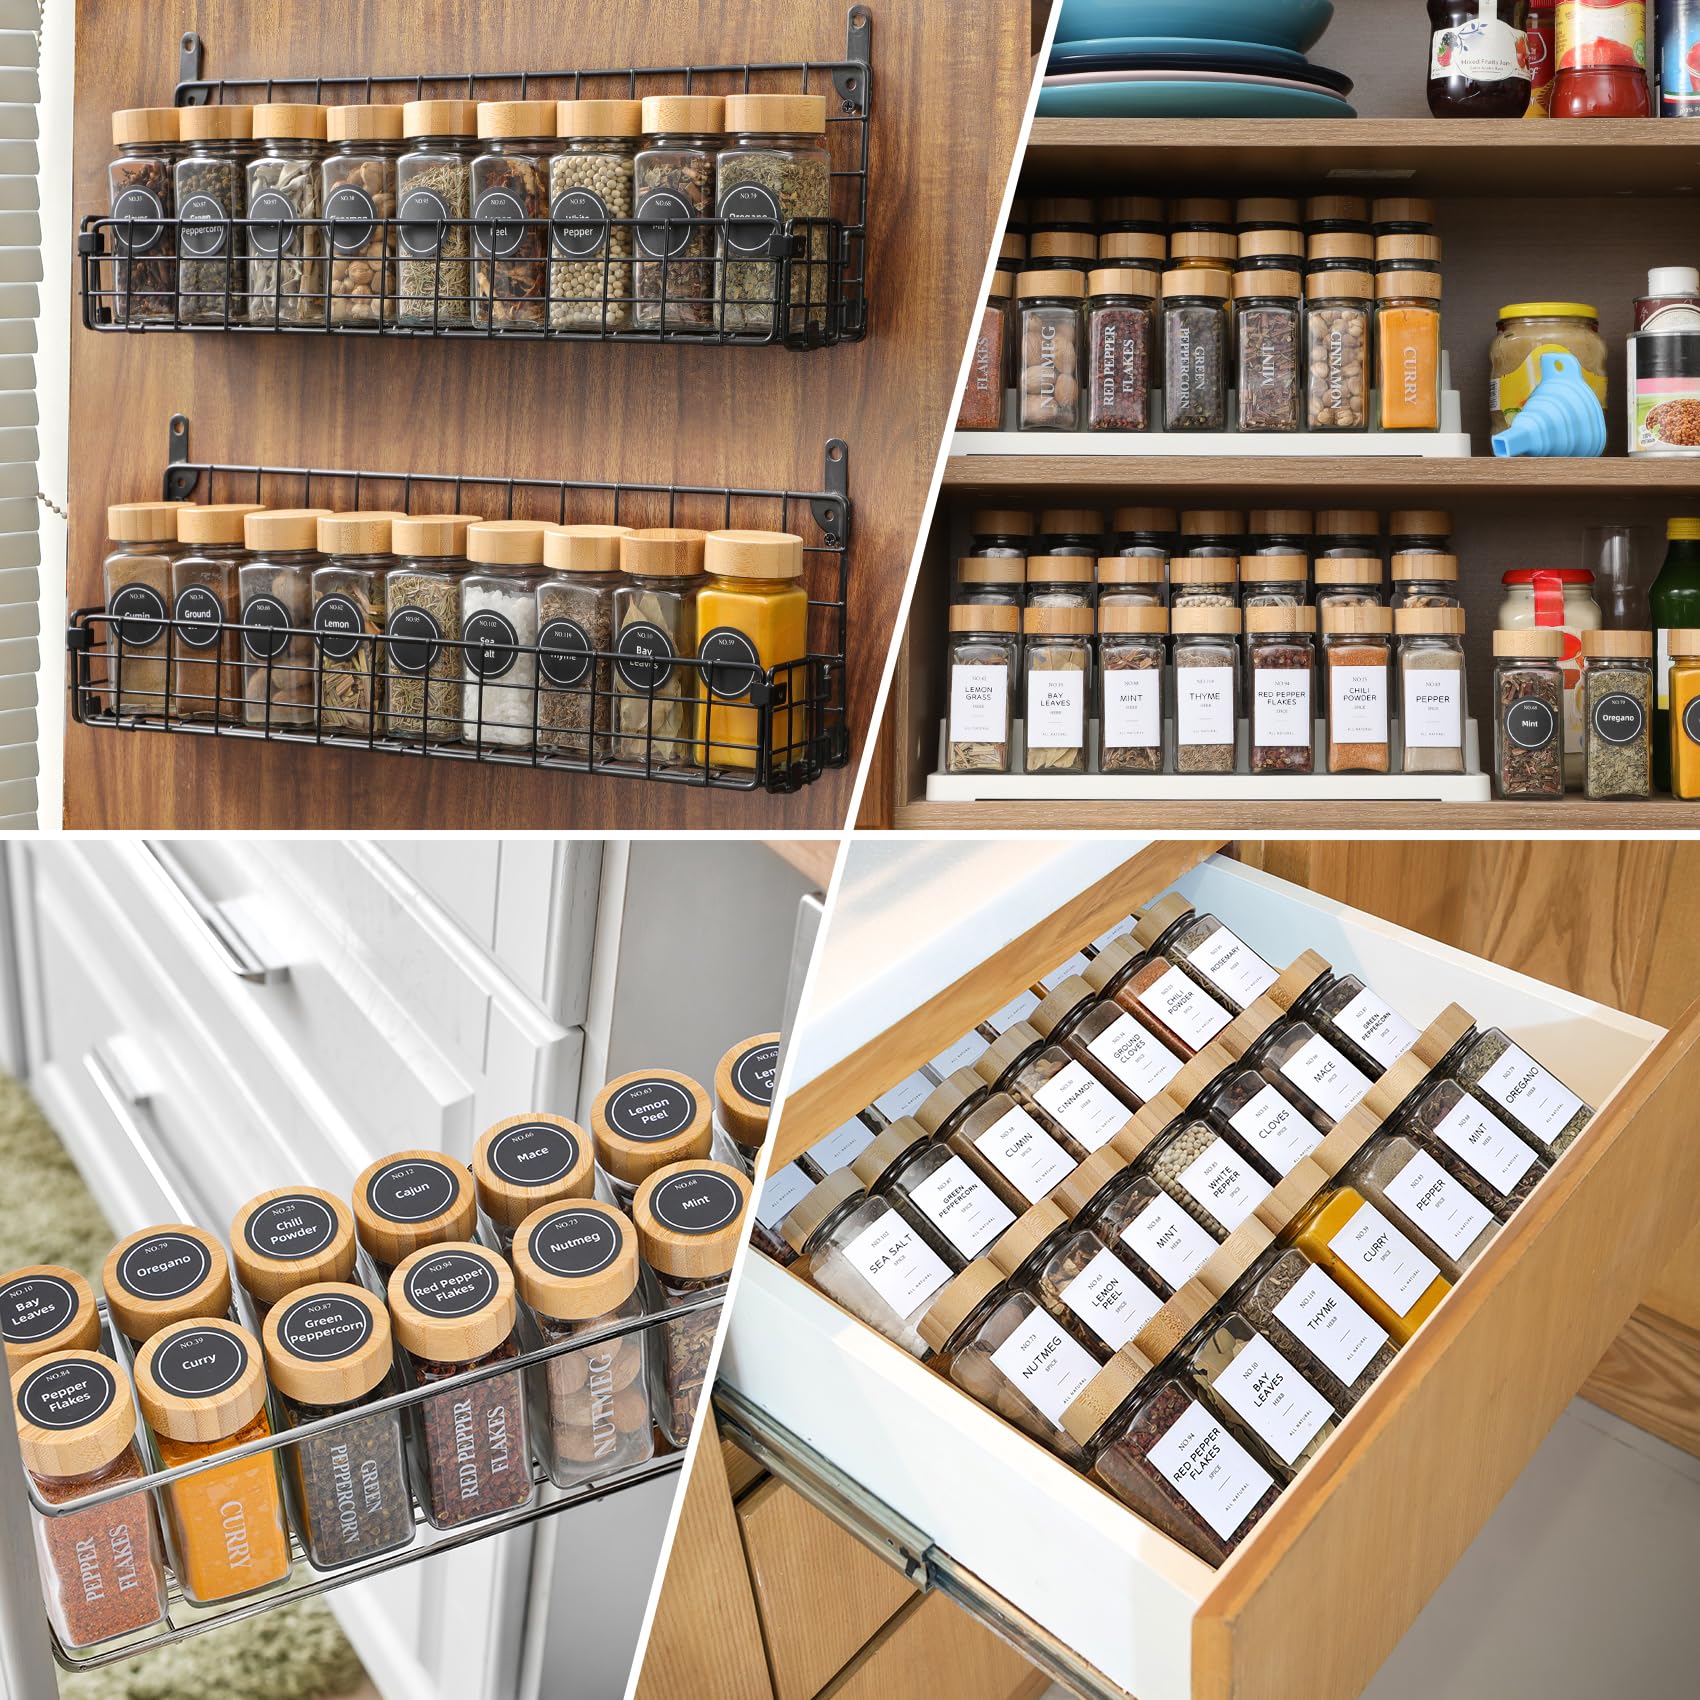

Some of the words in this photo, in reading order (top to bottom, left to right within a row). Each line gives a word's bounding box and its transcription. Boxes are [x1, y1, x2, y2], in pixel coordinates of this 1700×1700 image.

[181, 225, 222, 236] Peppercorn
[563, 227, 593, 238] Pepper
[1103, 326, 1116, 375] PEPPER
[977, 337, 988, 391] FLAKES
[1040, 326, 1056, 408] NUTMEG
[1123, 339, 1134, 393] FLAKES
[1180, 328, 1190, 409] PEPPERCORN
[1195, 346, 1205, 390] GREEN
[1262, 343, 1275, 387] MINT
[1331, 331, 1341, 409] CINNAMON
[1403, 346, 1417, 405] CURRY
[1103, 376, 1114, 406] RED
[185, 609, 211, 619] Ground
[325, 619, 350, 629] Lemon
[482, 650, 495, 658] alt
[636, 645, 653, 657] Bay
[1602, 714, 1634, 722] Oregano
[1210, 946, 1240, 974] ROSEMARY
[1166, 990, 1184, 1007] CHILI
[1168, 991, 1195, 1015] POWDER
[1362, 1012, 1391, 1041] PEPPERCORN
[1363, 1013, 1380, 1030] GREEN
[1113, 1034, 1140, 1060] GROUND
[1120, 1040, 1146, 1064] CLOVES
[1314, 1060, 1336, 1083] MACE
[630, 1087, 653, 1099] NO.63
[1057, 1080, 1095, 1114] CINNAMON
[1505, 1066, 1539, 1104] OREGANO
[628, 1098, 670, 1118] Lemon
[641, 1109, 669, 1125] Peel
[1258, 1109, 1290, 1139] CLOVES
[1468, 1122, 1488, 1145] MINT
[511, 1131, 535, 1144] NO.66
[1005, 1132, 1033, 1158] CUMIN
[517, 1146, 549, 1163] Mace
[391, 1169, 414, 1181] NO.12
[674, 1179, 698, 1192] NO.68
[1208, 1166, 1233, 1190] WHITE
[1213, 1171, 1241, 1198] PEPPER
[395, 1182, 430, 1200] Cajun
[681, 1194, 711, 1210] Mint
[938, 1183, 978, 1218] PEPPERCORN
[943, 1184, 964, 1204] GREEN
[1416, 1179, 1446, 1211] PEPPER
[272, 1204, 296, 1216] NO.25
[270, 1224, 318, 1245] Powder
[276, 1216, 303, 1232] Chili
[555, 1218, 578, 1230] NO.73
[144, 1242, 168, 1254] NO.79
[550, 1230, 601, 1254] Nutmeg
[1156, 1224, 1179, 1249] MINT
[1363, 1232, 1390, 1263] CURRY
[136, 1254, 191, 1277] Oregano
[869, 1255, 890, 1274] SEA
[889, 1233, 913, 1256] SALT
[428, 1261, 452, 1273] NO.94
[9, 1286, 34, 1299] NO.10
[414, 1282, 438, 1297] Red
[439, 1267, 484, 1289] Pepper
[435, 1283, 475, 1302] Flakes
[1092, 1277, 1119, 1307] LEMON
[16, 1297, 40, 1312] Bay
[308, 1303, 332, 1313] NO.87
[1102, 1291, 1123, 1310] PEEL
[11, 1302, 56, 1326] Leaves
[305, 1313, 343, 1329] Green
[1307, 1297, 1337, 1331] THYME
[180, 1337, 204, 1350] NO.39
[290, 1320, 364, 1344] Peppercorn
[1020, 1334, 1037, 1352] NO.73
[182, 1353, 216, 1370] Curry
[1022, 1335, 1062, 1379] NUTMEG
[46, 1369, 70, 1382] NO.84
[1243, 1361, 1259, 1380] NO.10
[1252, 1372, 1269, 1393] BAY
[41, 1380, 88, 1403] Pepper
[49, 1392, 90, 1413] Flakes
[1254, 1373, 1284, 1408] LEAVES
[1272, 1392, 1285, 1406] HERB
[589, 1353, 616, 1458] NUTMEG
[454, 1398, 476, 1463] PEPPER
[1289, 1426, 1298, 1436] ALL
[1296, 1409, 1312, 1427] NATURAL
[487, 1405, 508, 1475] FLAKES
[1178, 1432, 1196, 1452] NO.94
[1173, 1460, 1192, 1482] RED
[1190, 1427, 1221, 1462] PEPPER
[1189, 1444, 1221, 1481] FLAKES
[460, 1464, 479, 1500] RED
[1208, 1464, 1222, 1480] SPICE
[330, 1442, 360, 1544] PEPPERCORN
[360, 1459, 382, 1513] GREEN
[1225, 1502, 1234, 1512] ALL
[1232, 1483, 1249, 1502] NATURAL
[220, 1500, 250, 1570] CURRY
[75, 1536, 104, 1602] PEPPER
[109, 1524, 138, 1593] FLAKES
